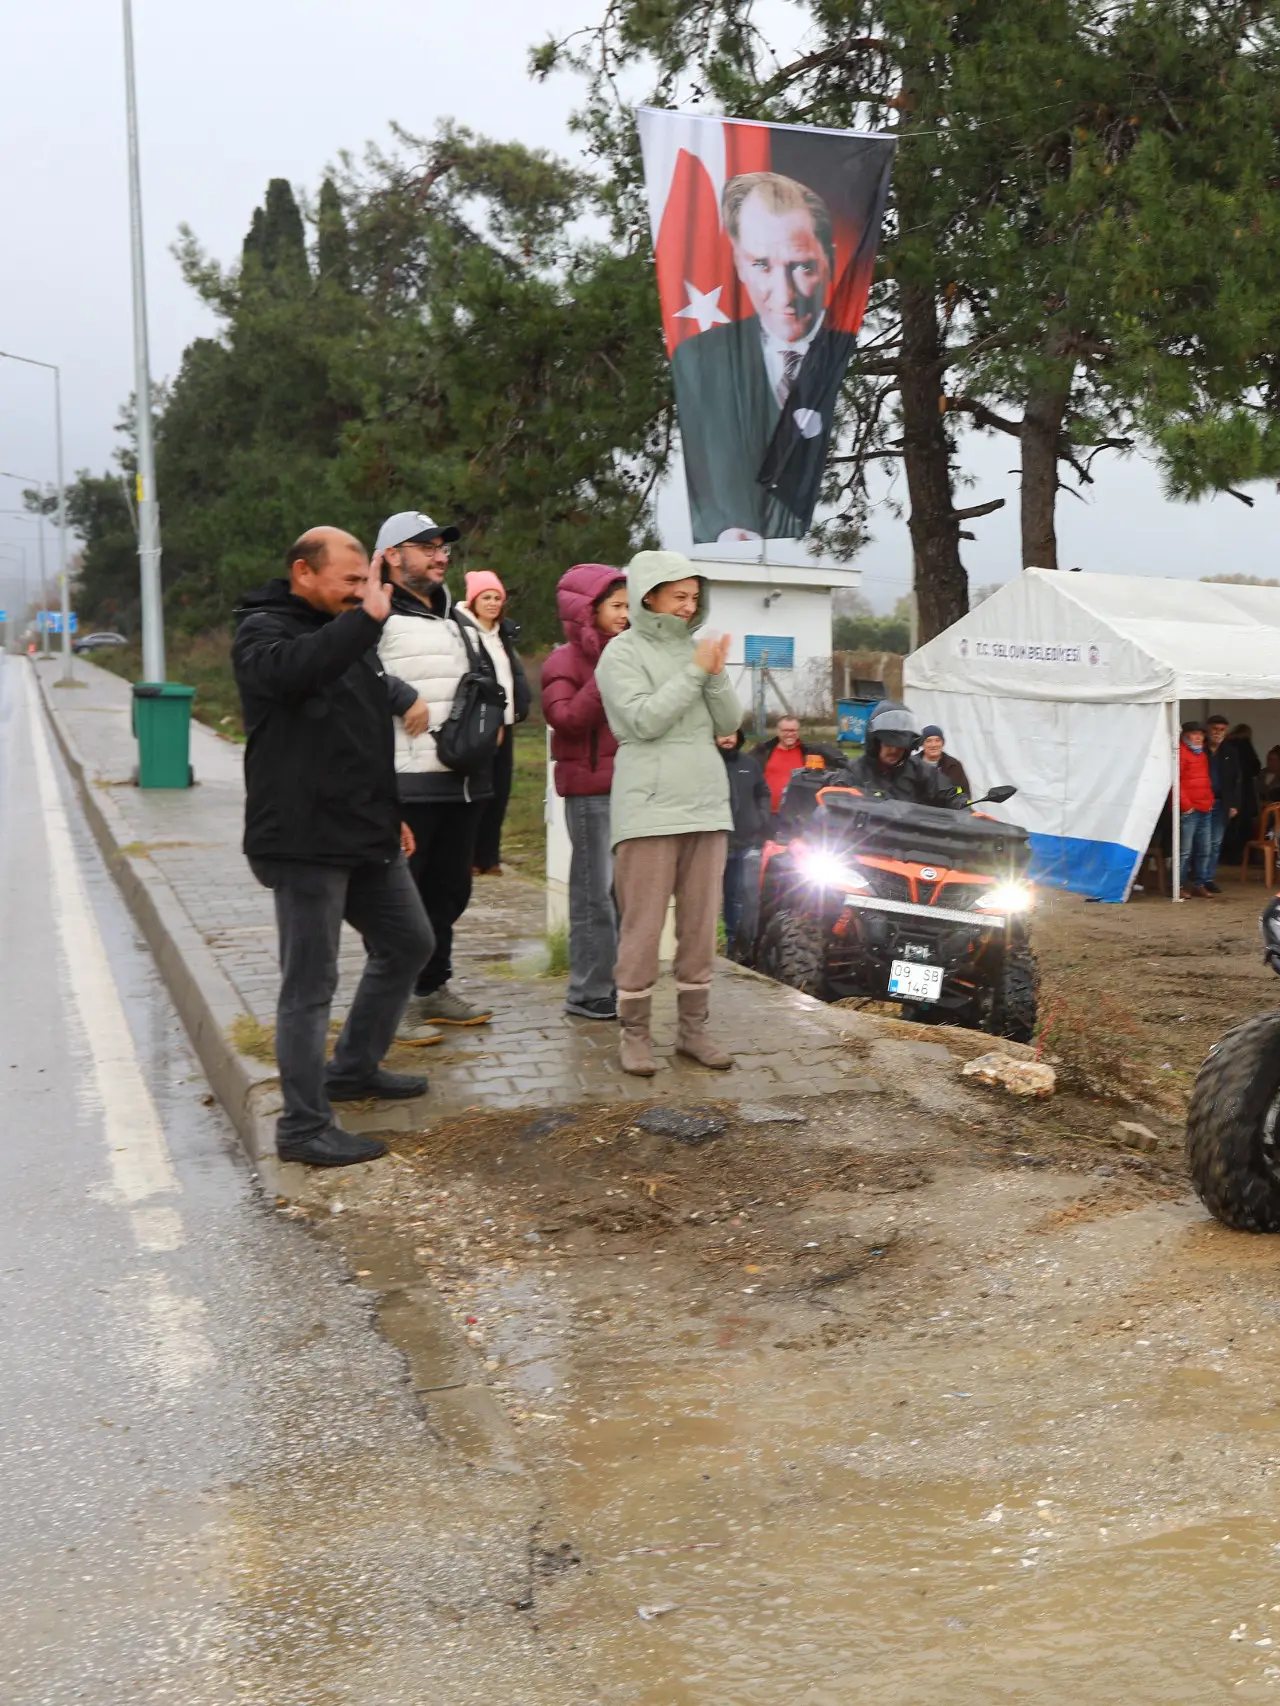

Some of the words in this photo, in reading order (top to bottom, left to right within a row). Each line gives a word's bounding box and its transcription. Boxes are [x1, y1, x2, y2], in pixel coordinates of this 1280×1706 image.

[895, 965, 911, 978] 09
[924, 969, 939, 982] SB
[908, 981, 929, 995] 146
